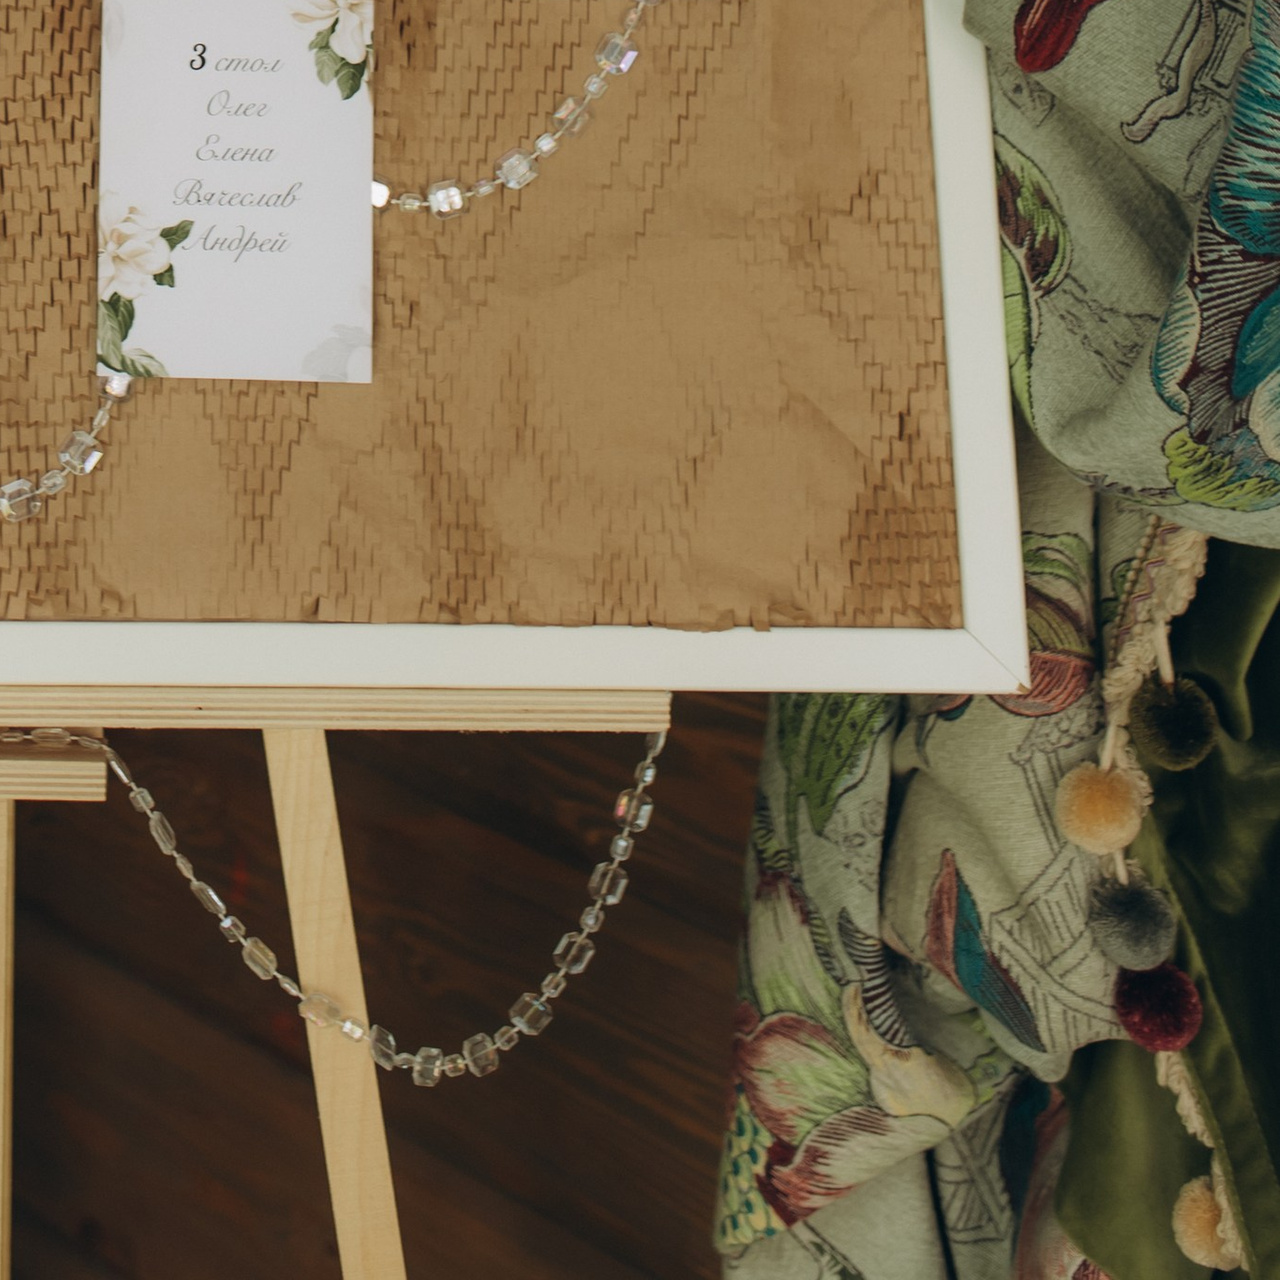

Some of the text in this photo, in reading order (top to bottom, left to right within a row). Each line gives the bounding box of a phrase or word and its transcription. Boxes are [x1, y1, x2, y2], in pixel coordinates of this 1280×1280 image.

[188, 42, 283, 73] 3 стол
[206, 89, 270, 117] Олег
[195, 134, 275, 162] Елена
[172, 178, 303, 208] Вячеслав
[181, 226, 290, 262] Андрей
